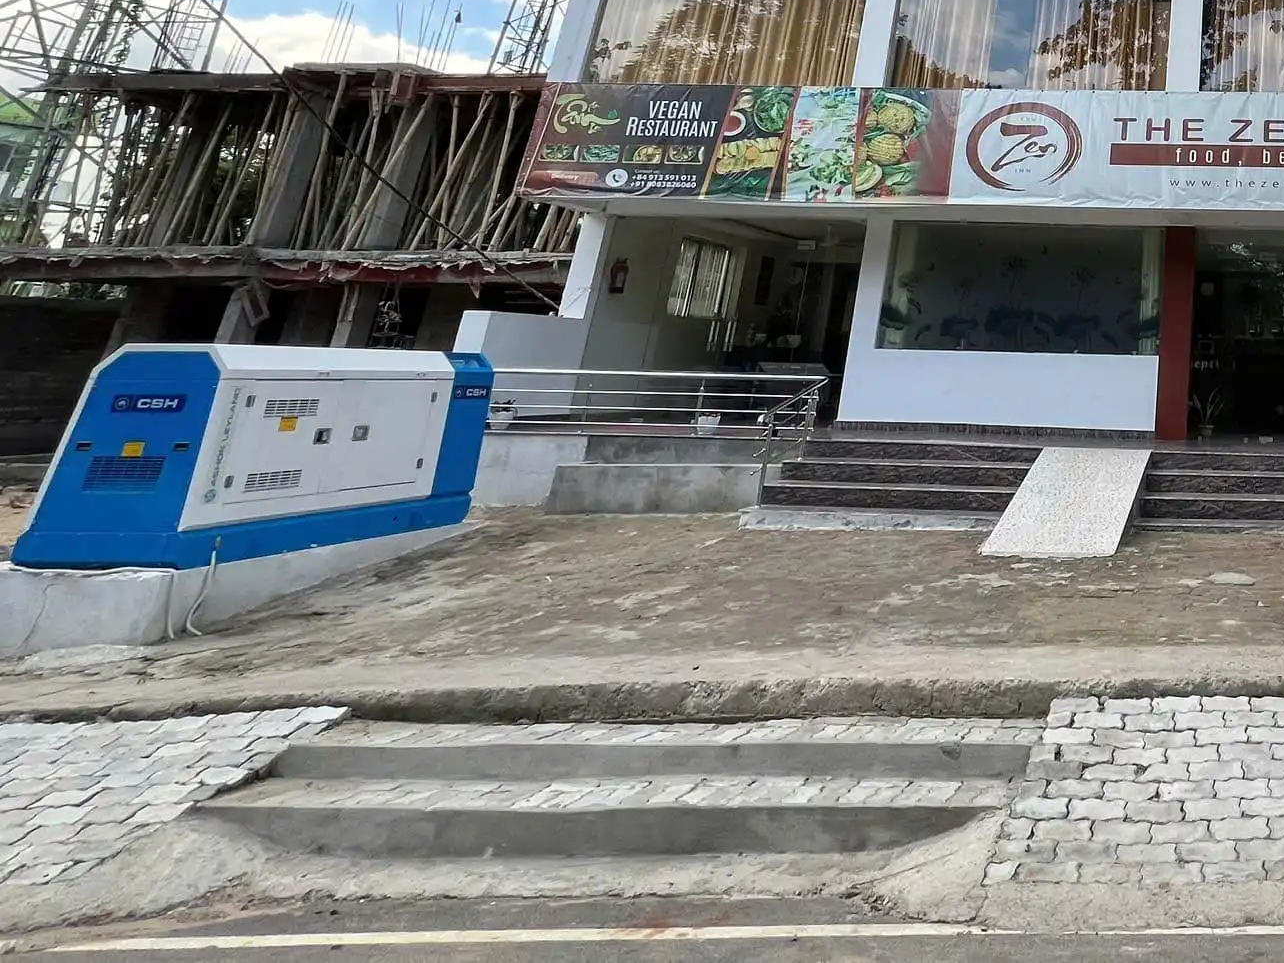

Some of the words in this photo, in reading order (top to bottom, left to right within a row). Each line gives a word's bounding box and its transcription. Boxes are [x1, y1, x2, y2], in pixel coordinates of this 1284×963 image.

[649, 100, 702, 120] VEGAN
[1113, 117, 1205, 142] THE
[990, 122, 1058, 172] Zen
[1175, 147, 1243, 166] food,
[466, 388, 487, 397] CSH
[136, 398, 179, 409] CSH
